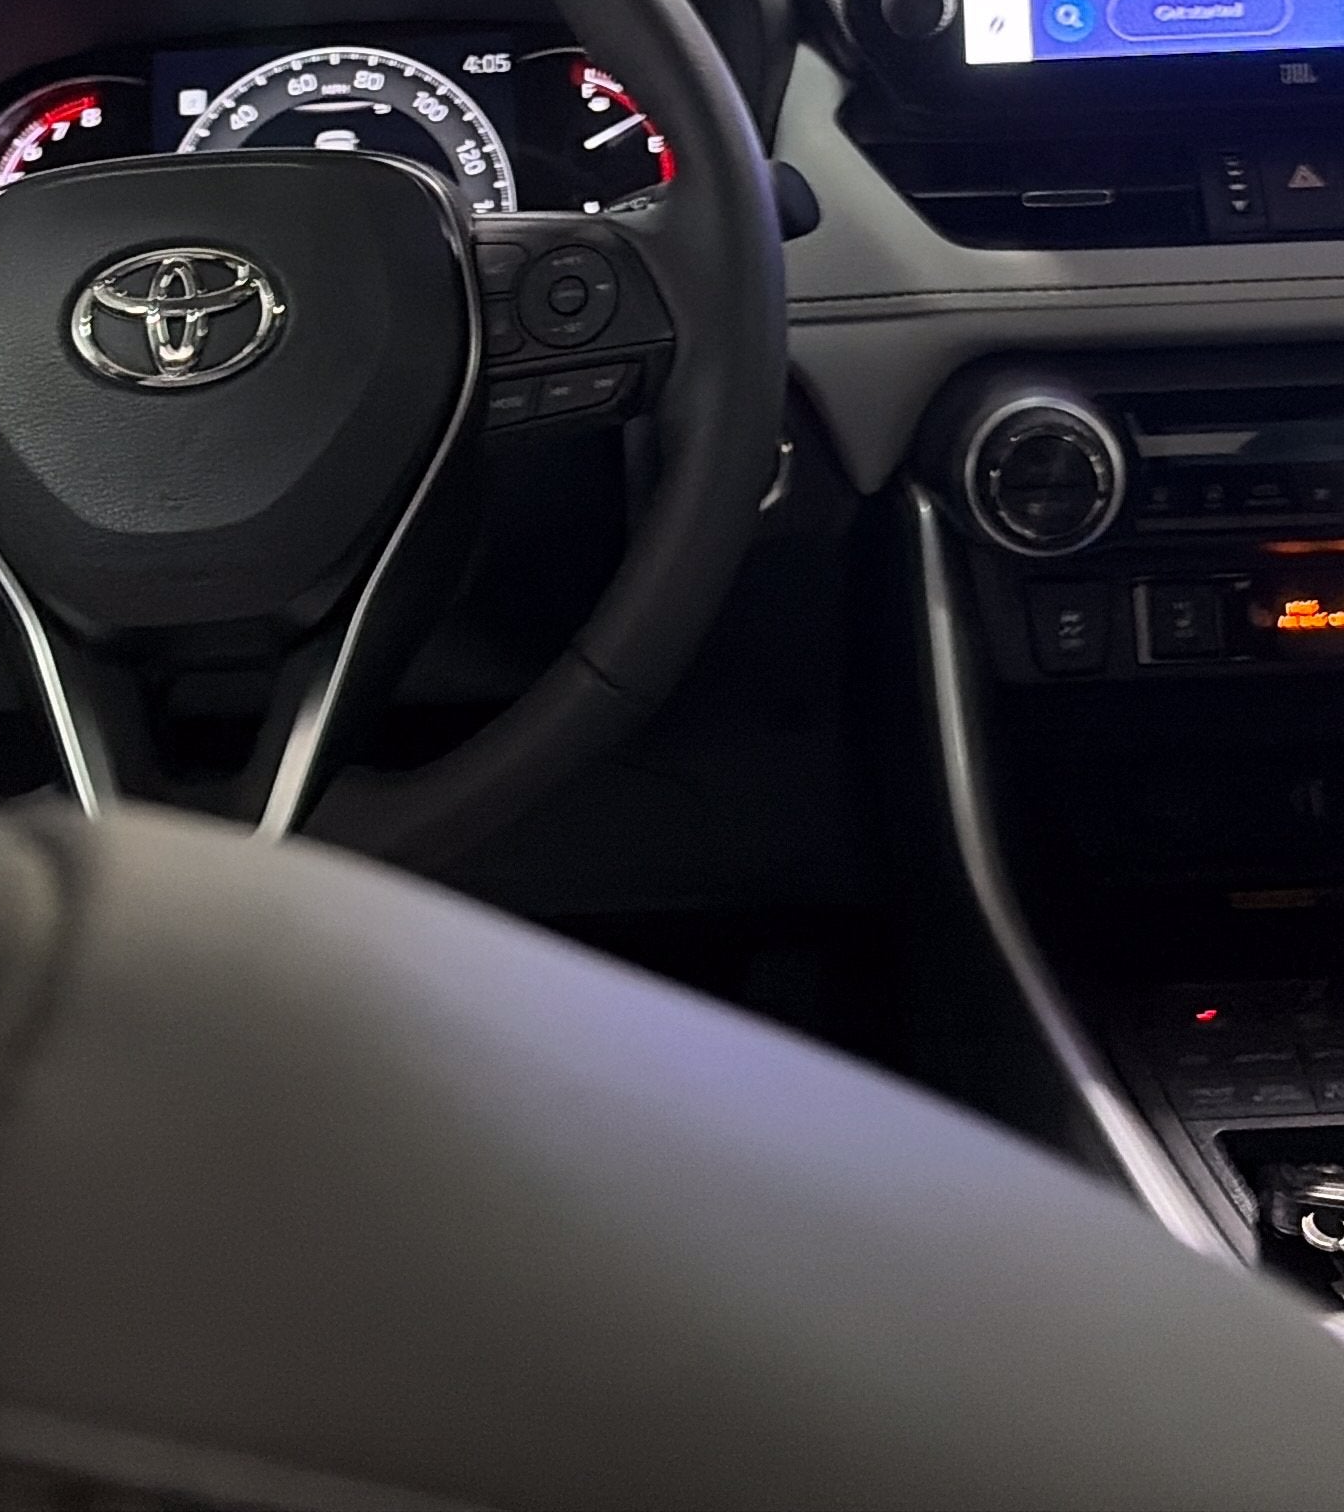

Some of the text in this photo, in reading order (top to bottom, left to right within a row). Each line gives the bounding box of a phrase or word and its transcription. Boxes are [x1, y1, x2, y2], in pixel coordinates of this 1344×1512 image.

[462, 53, 512, 74] 4:05
[1279, 63, 1319, 84] JBL
[287, 73, 318, 96] 60
[353, 70, 385, 91] 80
[412, 90, 449, 122] 100
[80, 107, 102, 128] 8
[229, 104, 258, 130] 40
[50, 121, 71, 141] 7
[22, 141, 43, 162] 6
[456, 139, 486, 175] 120
